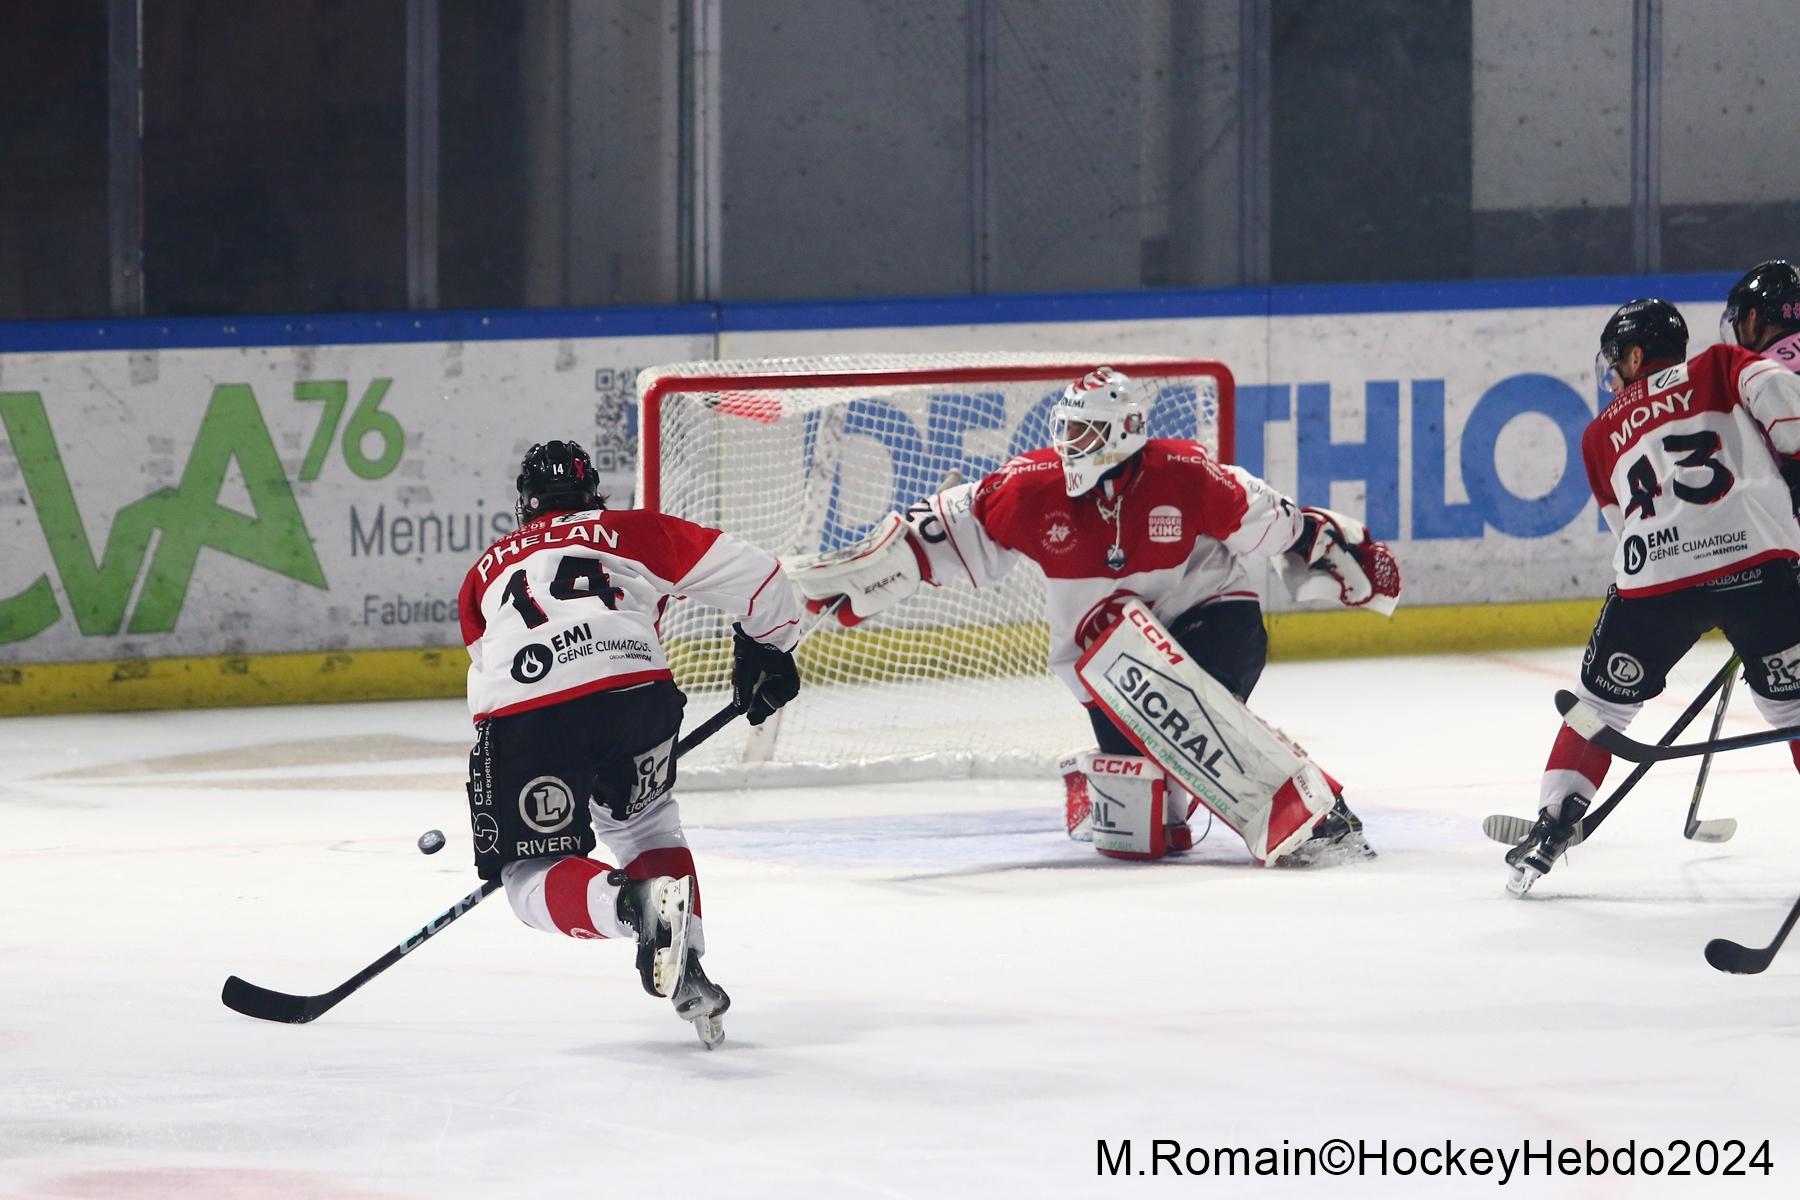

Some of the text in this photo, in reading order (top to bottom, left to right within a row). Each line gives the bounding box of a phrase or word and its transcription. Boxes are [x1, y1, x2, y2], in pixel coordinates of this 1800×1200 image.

[294, 377, 406, 481] 76
[1609, 389, 1694, 453] MONY
[552, 463, 564, 475] 14
[1625, 430, 1736, 521] 43
[1149, 516, 1182, 526] BURGER
[1149, 525, 1182, 536] KING
[1648, 526, 1679, 548] EMI
[1650, 531, 1747, 562] GÉNIE CLIMATIQUE
[1712, 544, 1748, 556] MENTION
[477, 524, 619, 583] PHELAN
[499, 555, 625, 630] 14
[551, 622, 593, 652] EMI
[1129, 609, 1184, 666] CCM
[557, 643, 593, 664] GÉNIE
[1595, 675, 1640, 697] RIVERY
[1769, 681, 1800, 693] Lhotelli
[1119, 666, 1224, 778] SICRAL
[484, 757, 492, 788] experts
[1092, 759, 1143, 776] CCM
[473, 768, 484, 806] CET
[1190, 778, 1231, 815] LOCAUX
[516, 836, 581, 856] RIVERY
[400, 887, 483, 954] CCM
